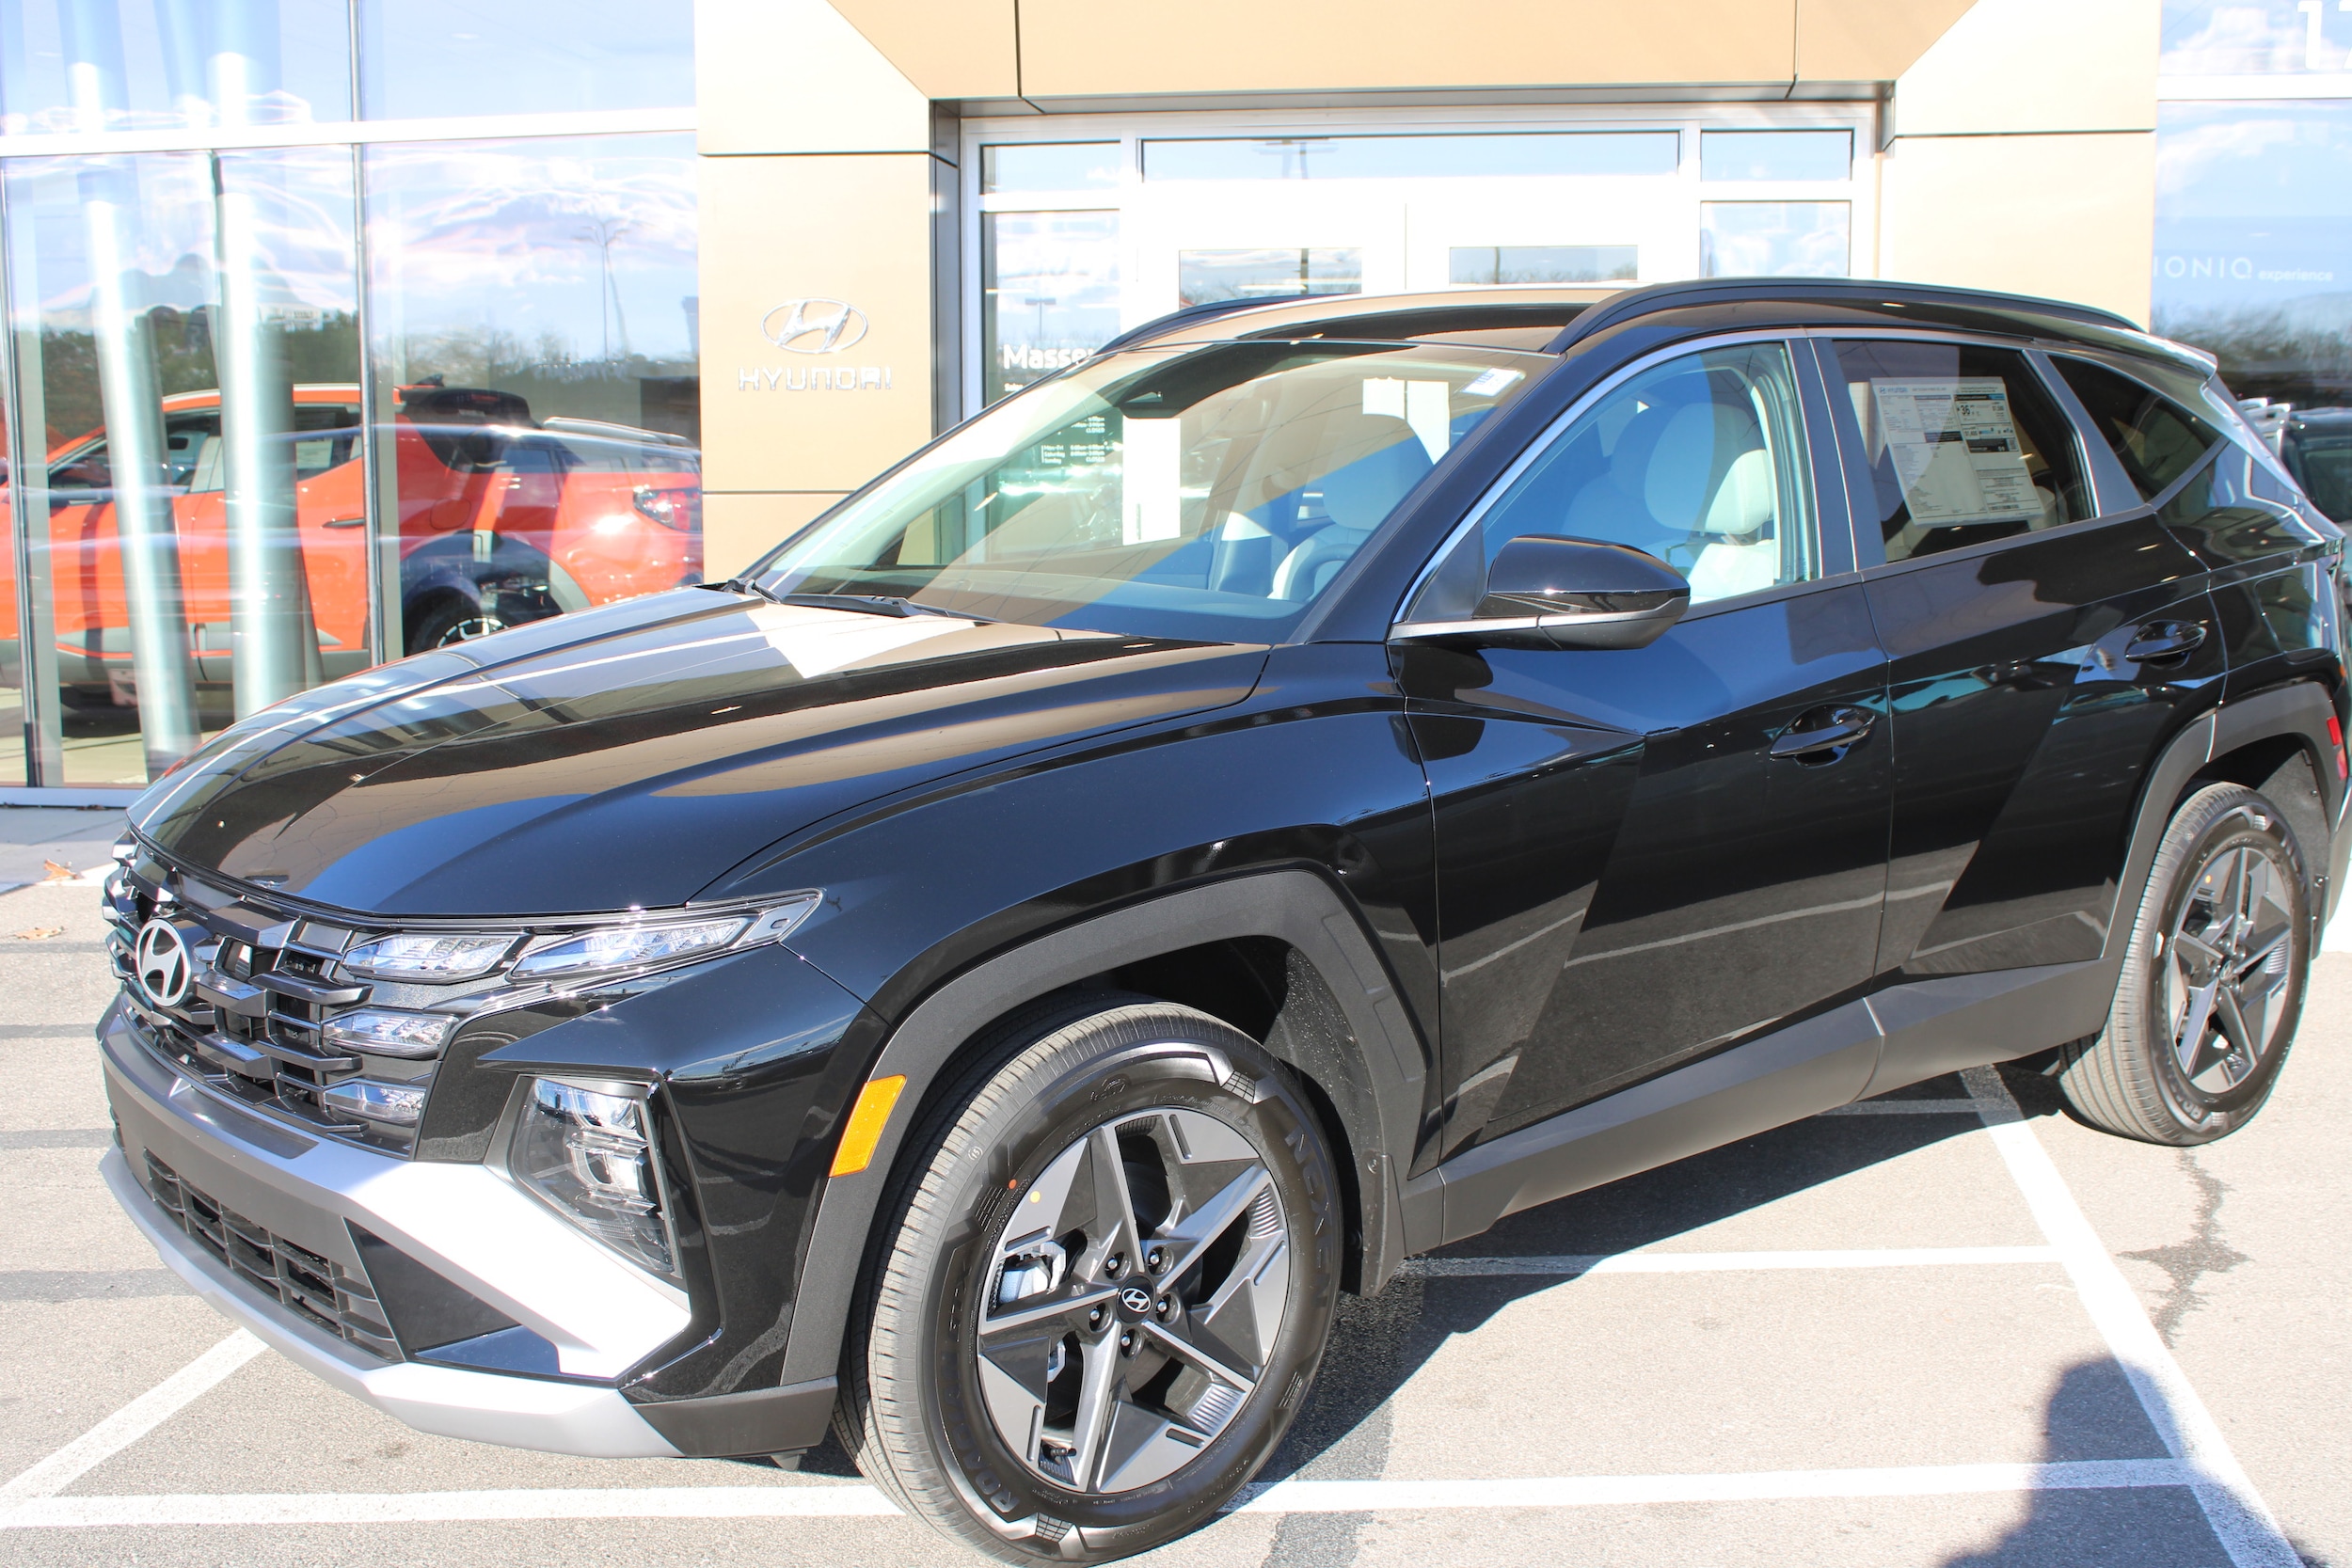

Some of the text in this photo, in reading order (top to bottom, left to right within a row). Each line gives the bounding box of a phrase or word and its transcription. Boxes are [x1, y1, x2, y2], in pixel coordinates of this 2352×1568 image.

[2153, 256, 2333, 282] IONIQ experience
[739, 367, 892, 391] HYUNDAI
[1284, 1124, 1331, 1308] NEXEN
